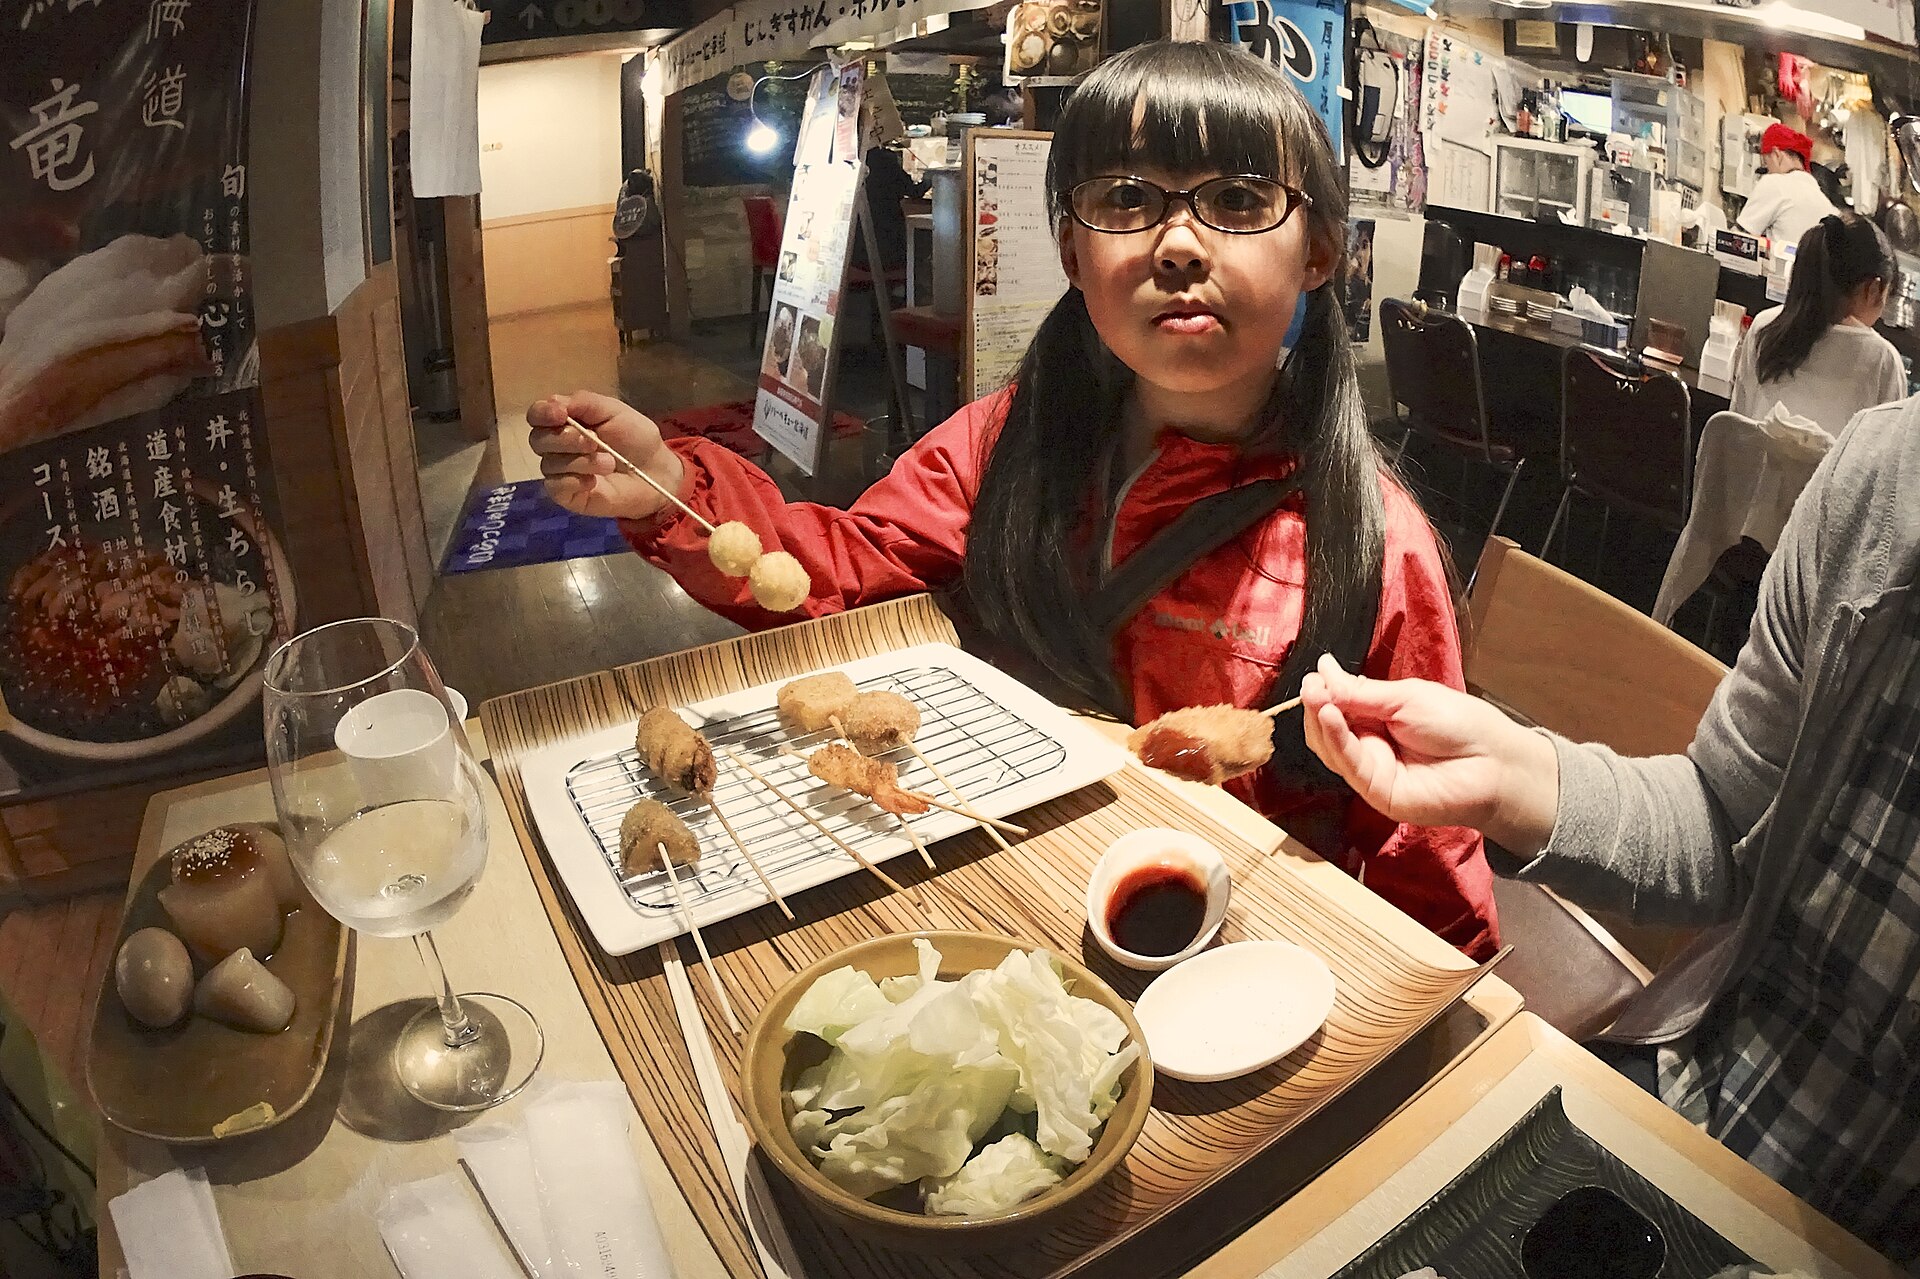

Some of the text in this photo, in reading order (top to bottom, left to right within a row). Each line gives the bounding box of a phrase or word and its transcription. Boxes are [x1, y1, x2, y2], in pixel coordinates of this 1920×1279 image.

[220, 164, 247, 329] 旬の素材を活かして
[33, 463, 67, 552] コース
[85, 446, 121, 522] 銘酒
